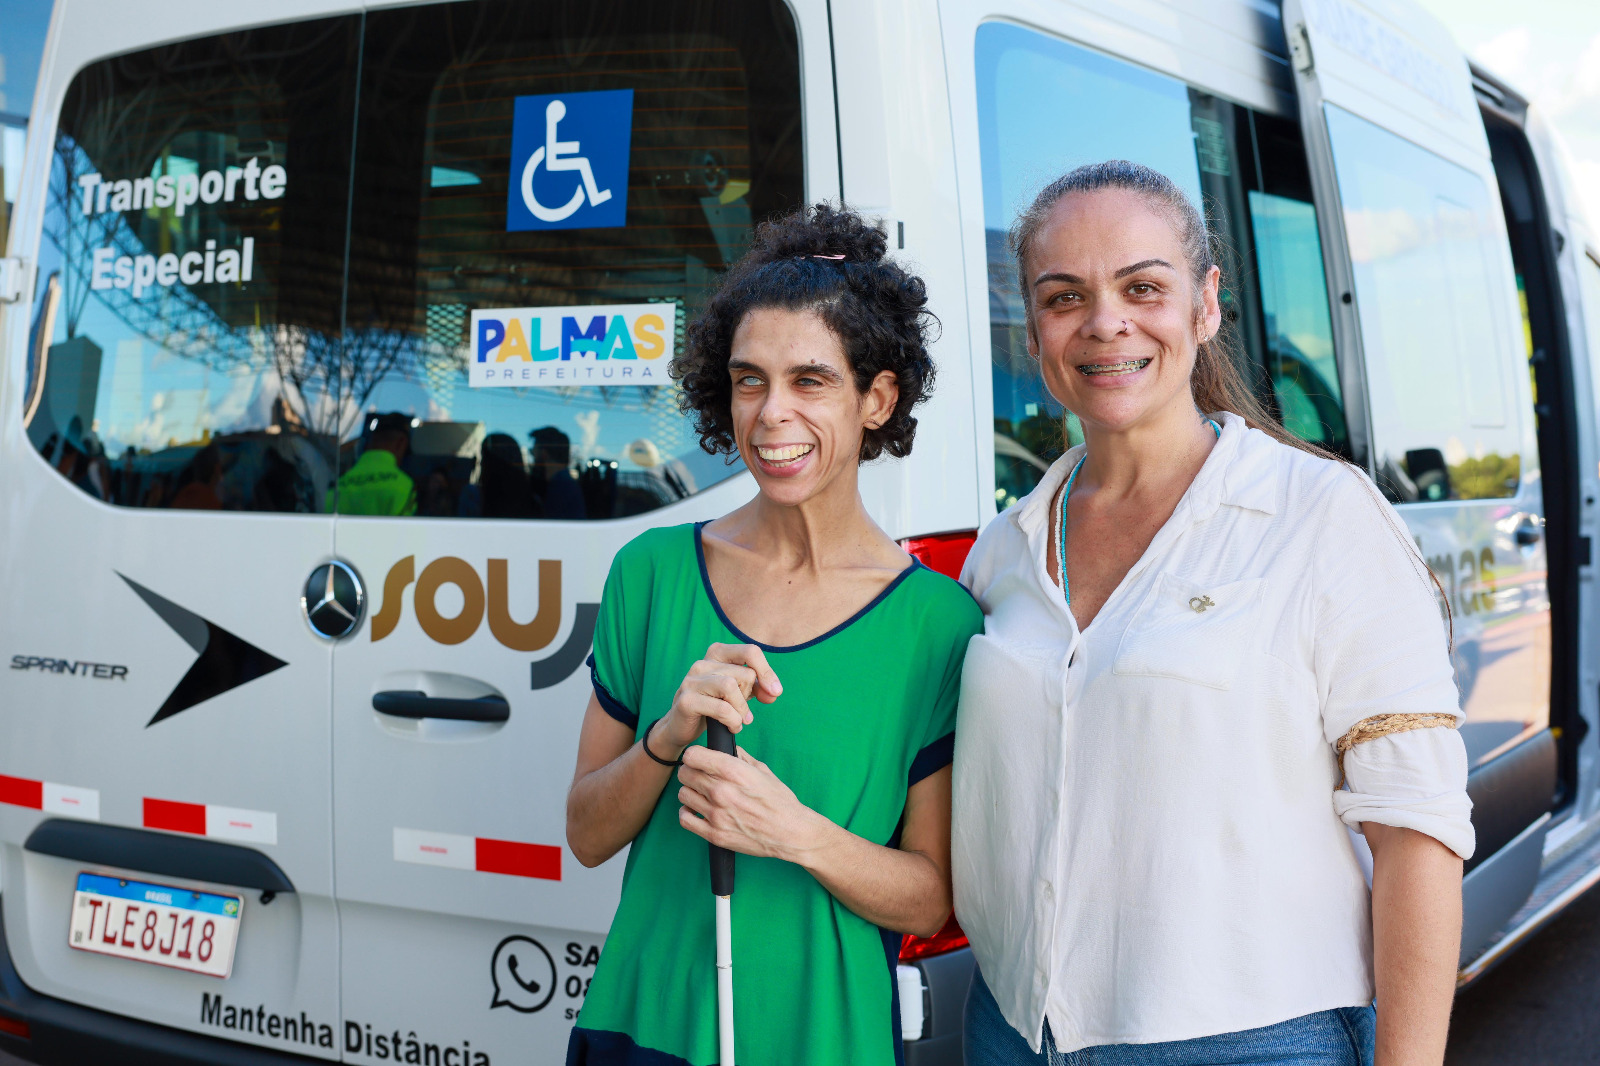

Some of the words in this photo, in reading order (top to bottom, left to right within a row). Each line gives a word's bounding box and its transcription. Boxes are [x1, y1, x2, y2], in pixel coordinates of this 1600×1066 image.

[78, 156, 287, 217] Transporte
[91, 237, 254, 298] Especial
[477, 313, 666, 363] PALMAS
[486, 367, 653, 380] PREFEITURA
[1415, 535, 1496, 619] mas
[10, 654, 129, 681] SPRINTER
[89, 899, 215, 962] TLE8J18
[564, 941, 601, 968] SA
[201, 992, 334, 1049] Mantenha
[345, 1020, 491, 1066] Distância
